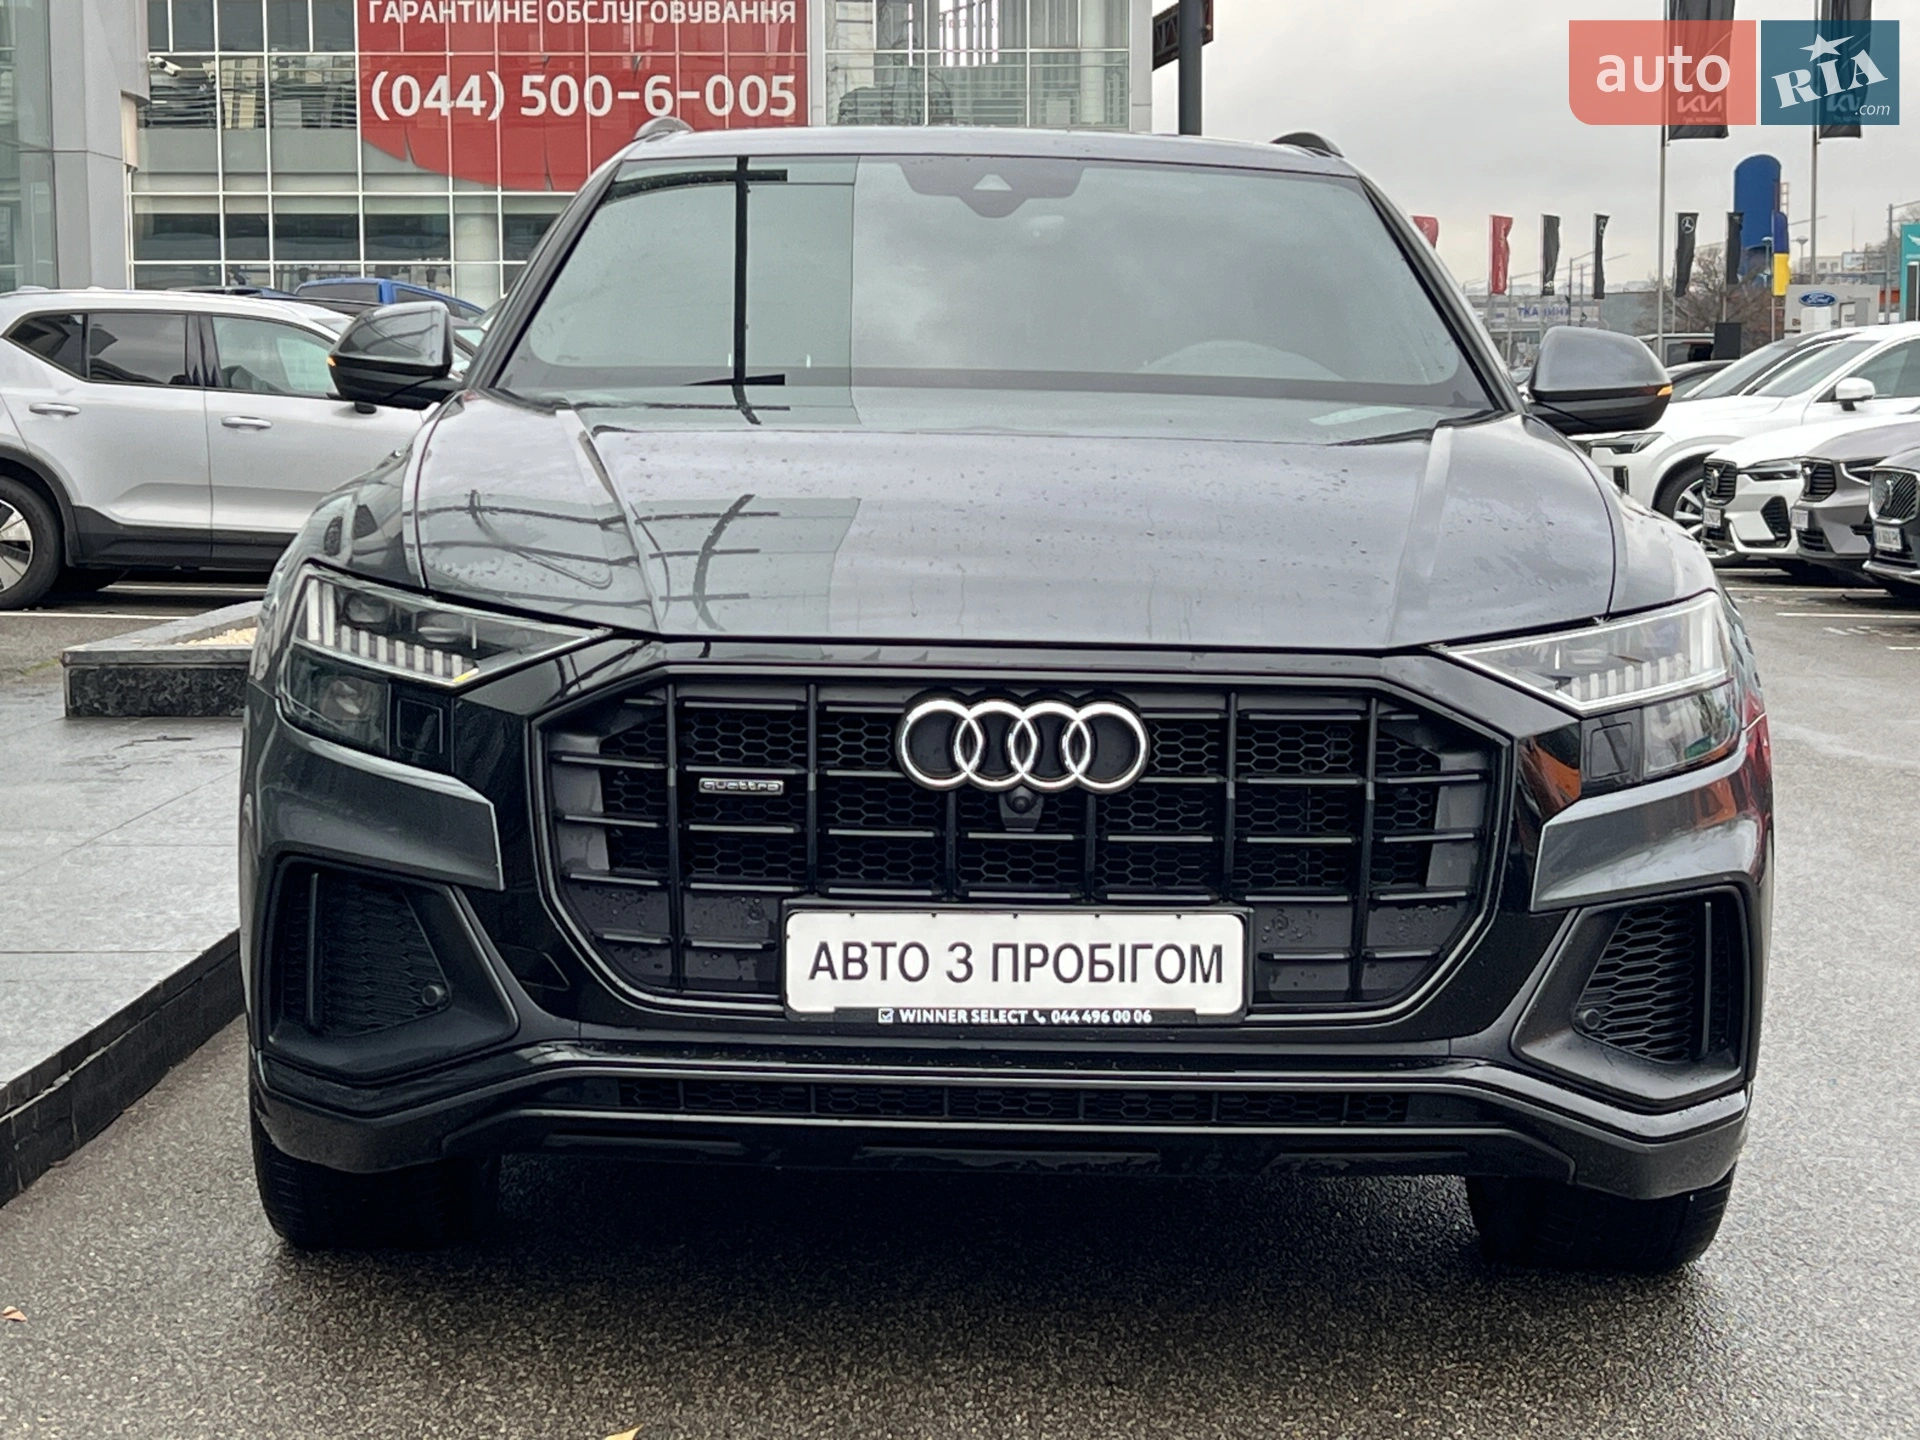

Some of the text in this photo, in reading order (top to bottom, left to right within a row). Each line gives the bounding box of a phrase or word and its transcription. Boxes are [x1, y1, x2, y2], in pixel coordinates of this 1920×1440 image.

[546, 0, 796, 24] ОБСЛУГОВУВАННЯ
[371, 71, 796, 121] (044) 500-6-005
[702, 780, 780, 792] quattro
[808, 941, 930, 982] АВТО
[991, 943, 1223, 984] ПРОБІГОМ
[899, 1008, 1153, 1024] WINNER SELECT 044 496 00 06
